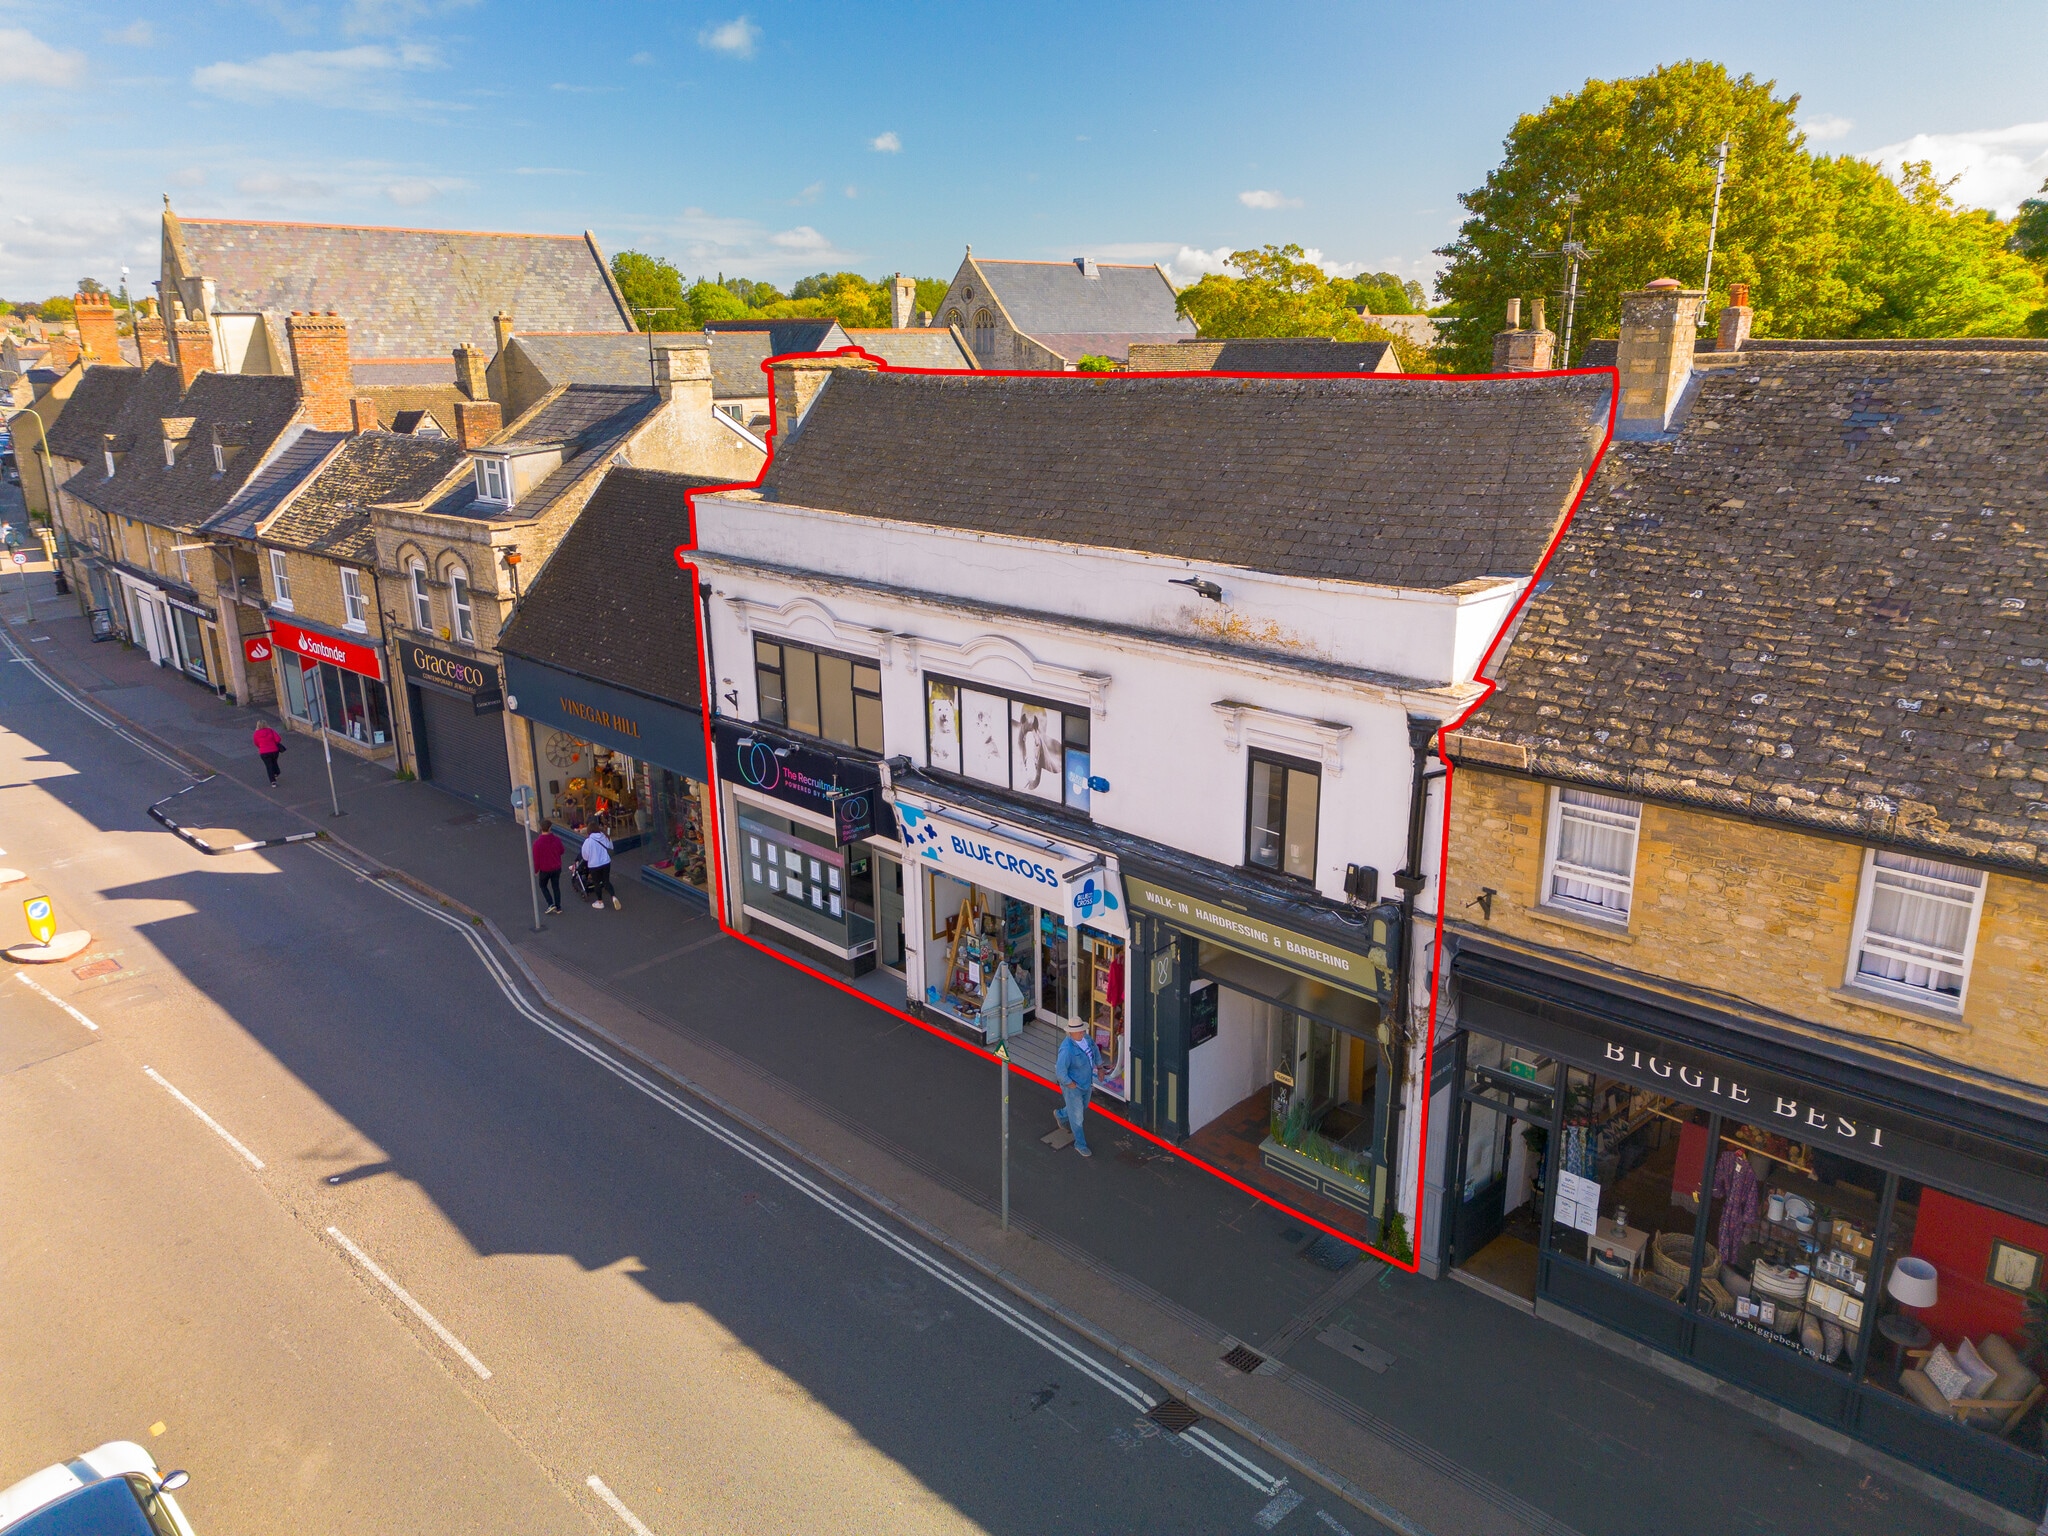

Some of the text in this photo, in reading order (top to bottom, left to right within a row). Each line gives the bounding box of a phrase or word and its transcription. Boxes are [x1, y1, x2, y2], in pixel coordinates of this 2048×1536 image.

[307, 637, 346, 663] Santander
[560, 696, 641, 738] VINEGAR HILL
[782, 767, 798, 781] The
[784, 780, 812, 794] POWERED
[813, 789, 821, 798] BY
[1076, 898, 1093, 907] CROSS
[1077, 893, 1089, 901] BLUE
[1178, 901, 1189, 915] IN
[1195, 908, 1269, 944] HAIRDRESSING
[1273, 937, 1281, 948] &
[1286, 940, 1350, 971] BARBERING
[1719, 1310, 1833, 1364] www.biggiebest.co.uk
